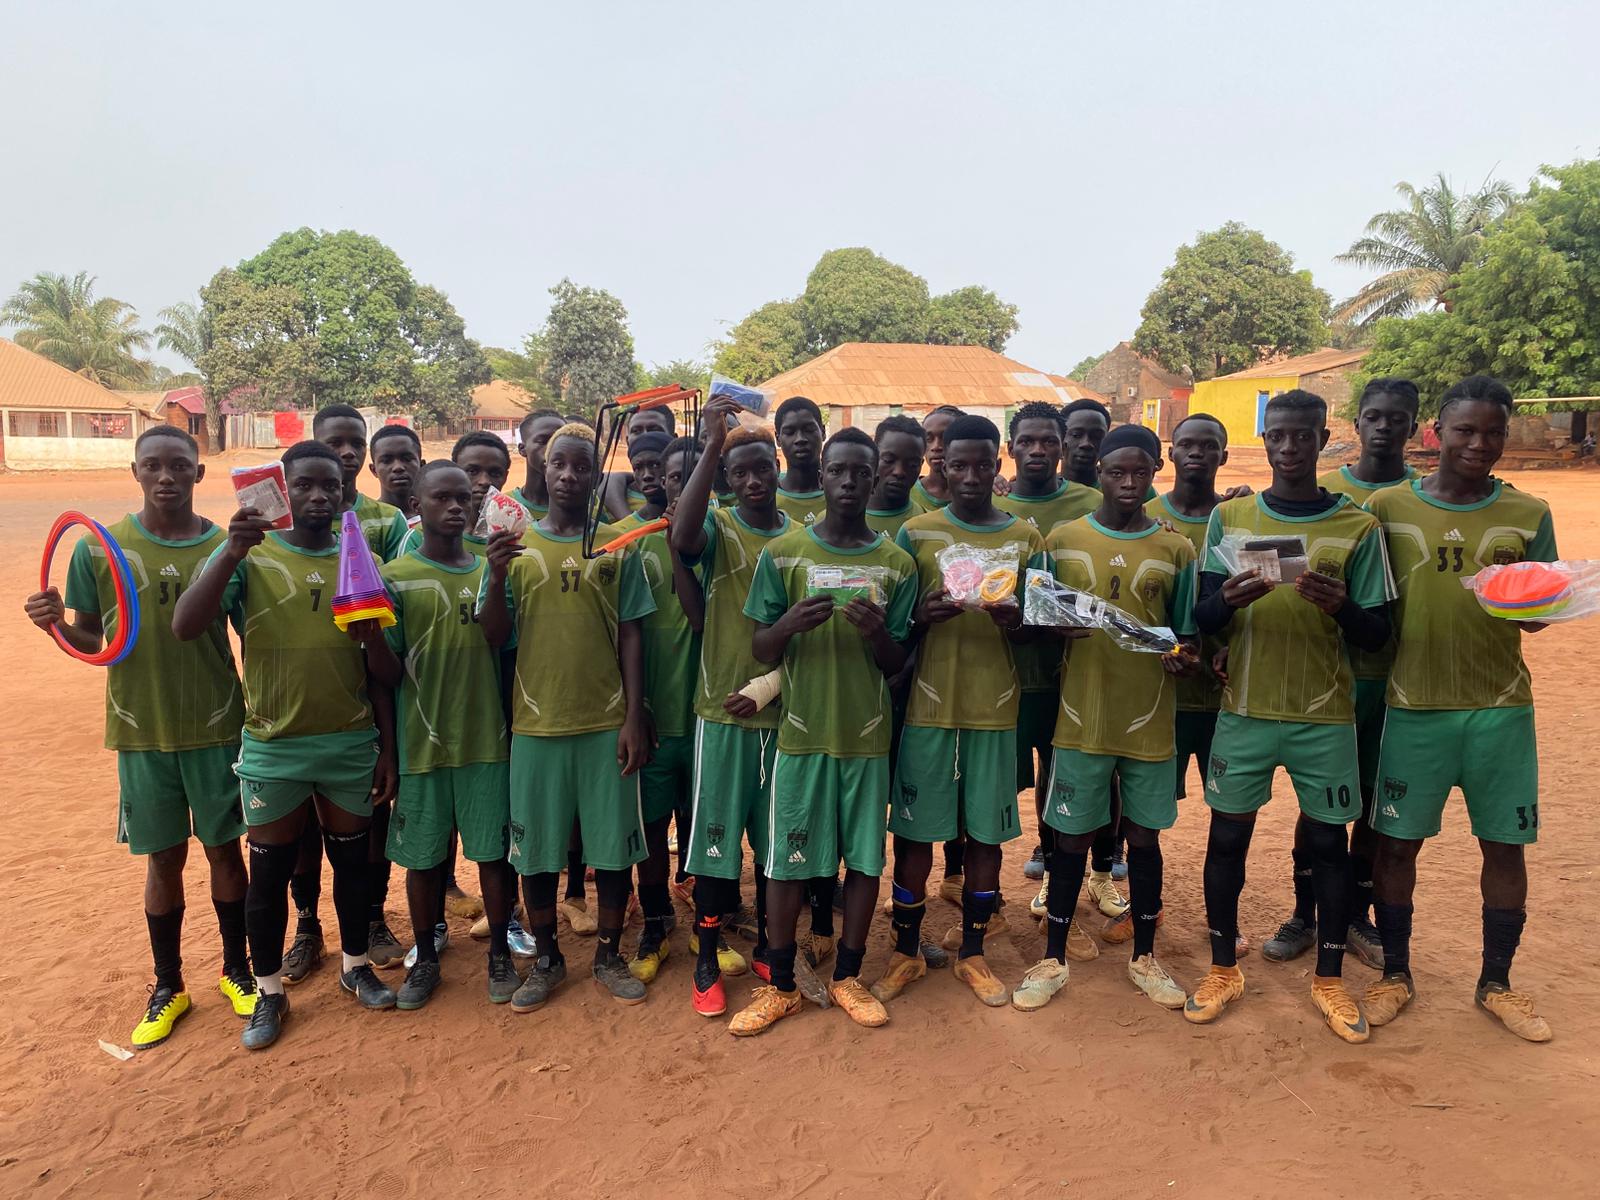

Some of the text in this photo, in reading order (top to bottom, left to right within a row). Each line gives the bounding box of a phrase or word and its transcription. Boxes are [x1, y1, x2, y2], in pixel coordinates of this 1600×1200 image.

[1437, 546, 1464, 572] 33
[560, 570, 581, 592] 37
[1110, 575, 1121, 600] 2
[310, 588, 322, 612] 7
[1326, 784, 1351, 809] 10
